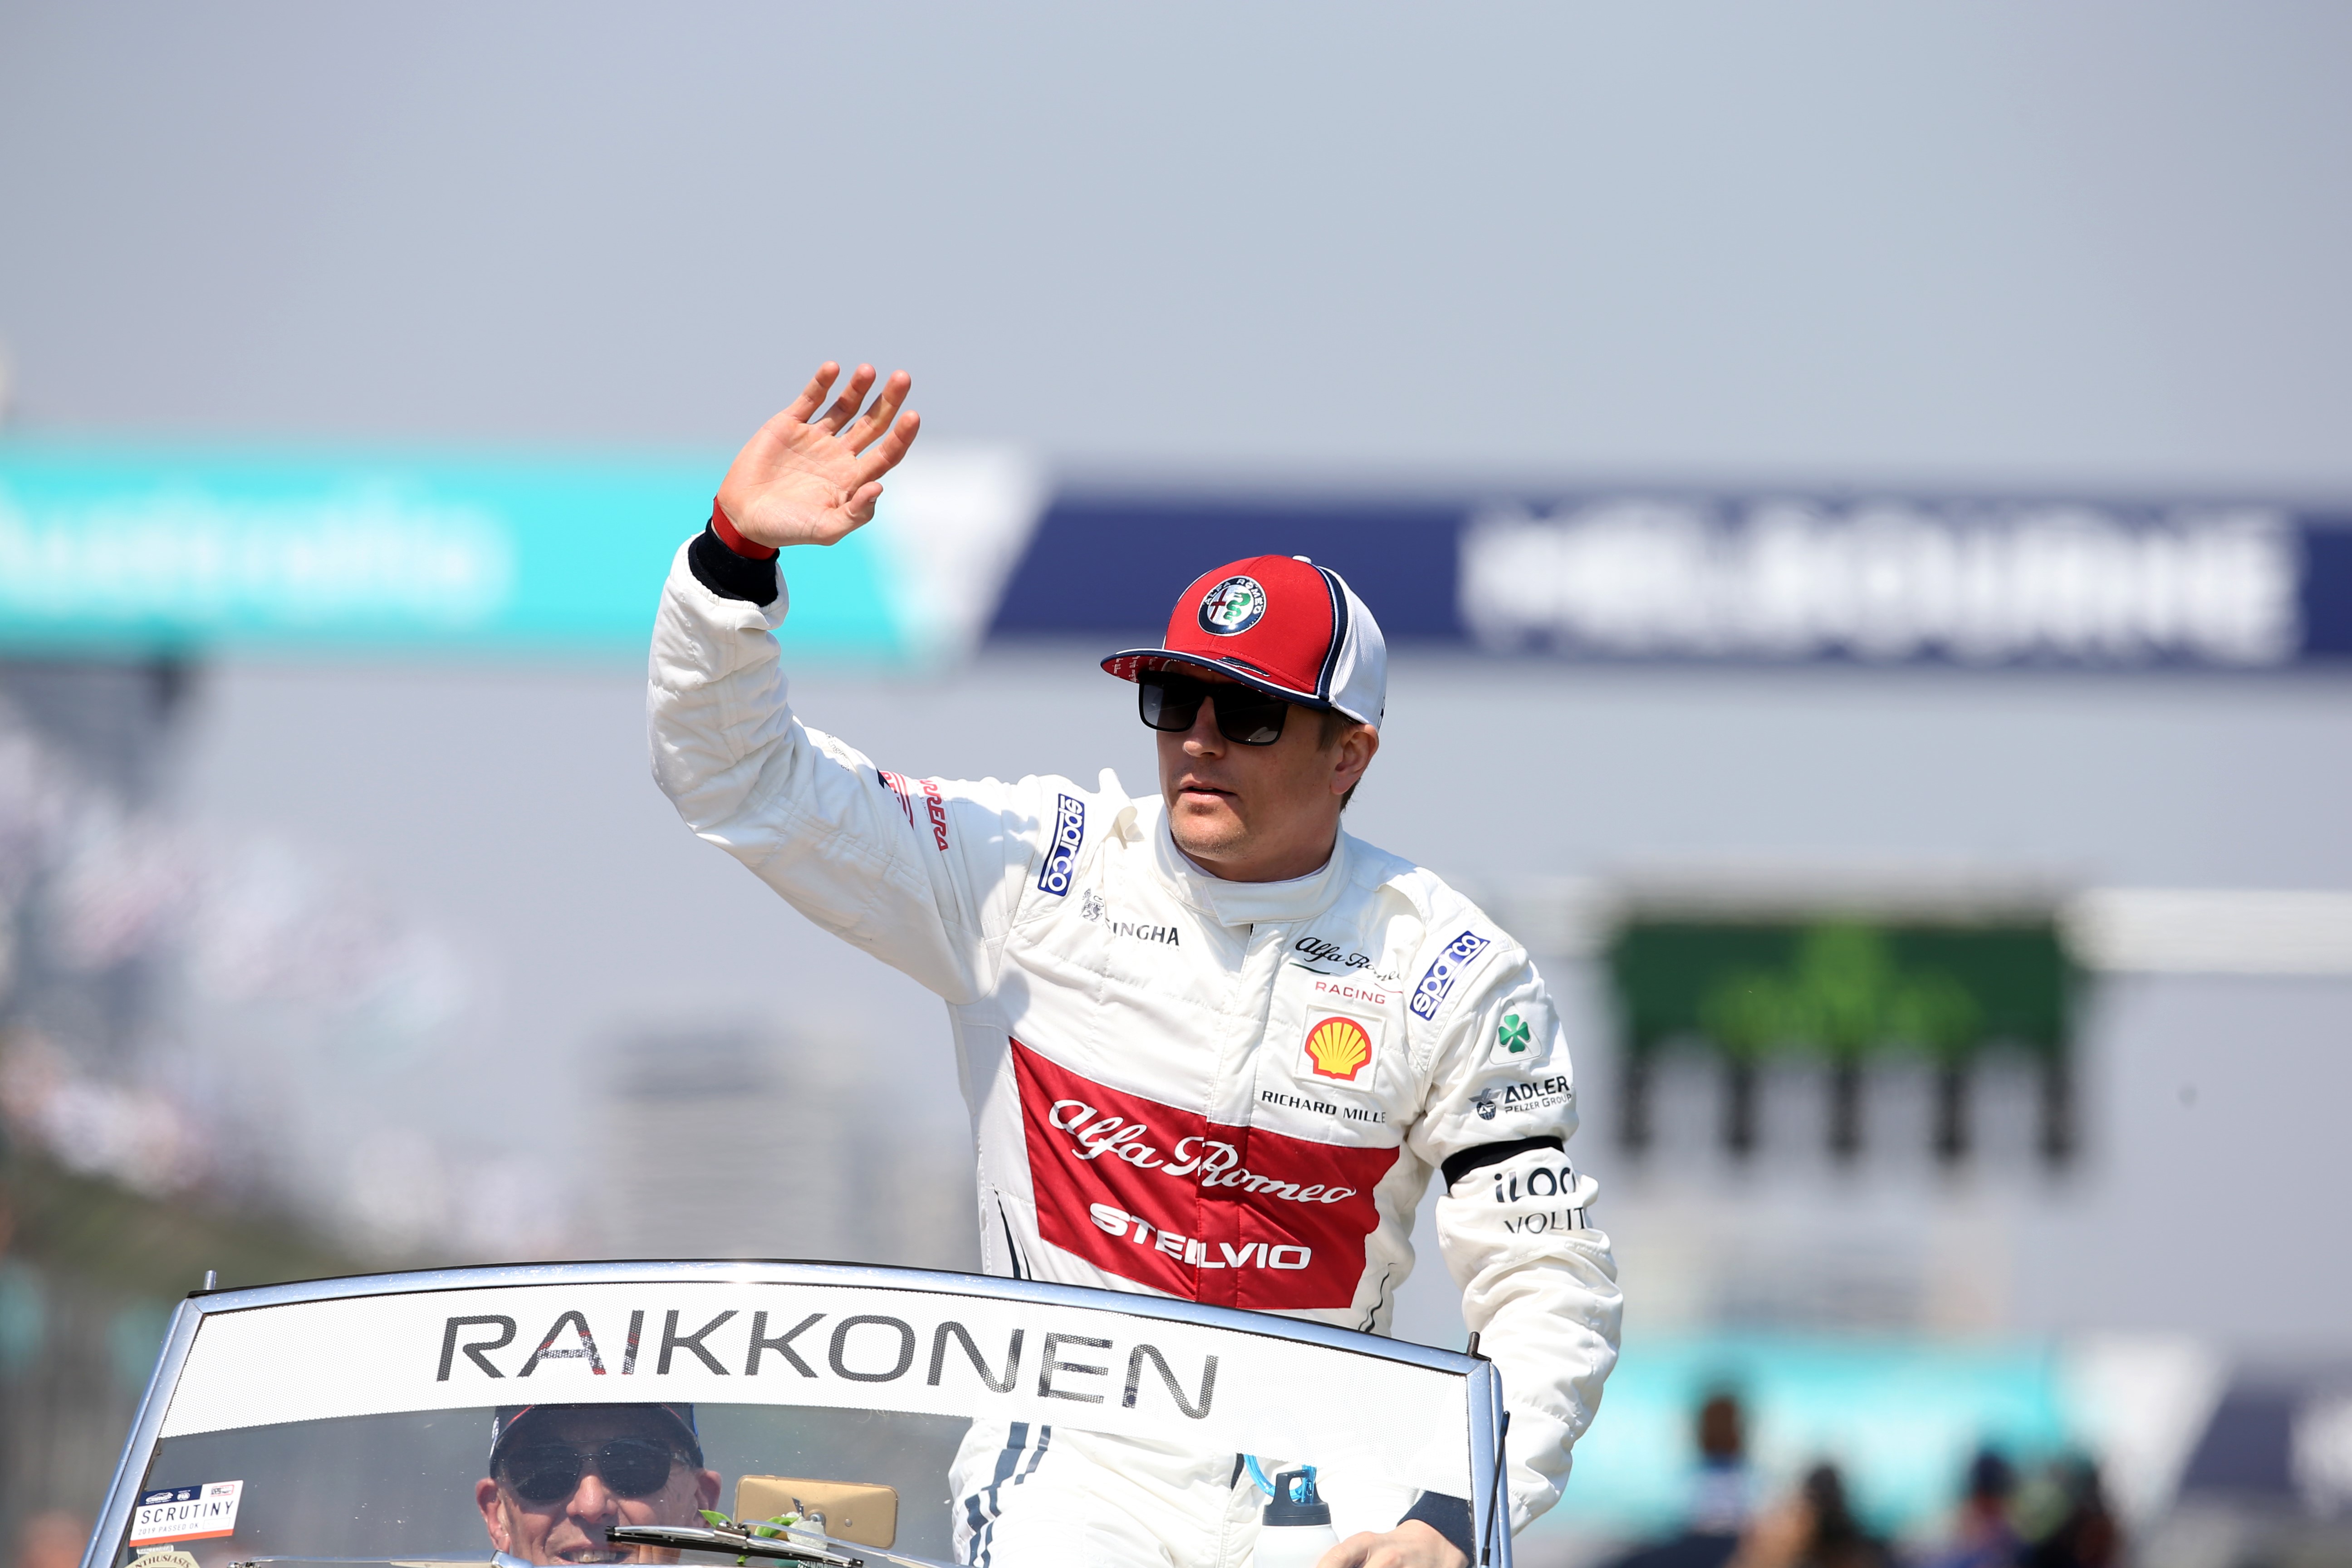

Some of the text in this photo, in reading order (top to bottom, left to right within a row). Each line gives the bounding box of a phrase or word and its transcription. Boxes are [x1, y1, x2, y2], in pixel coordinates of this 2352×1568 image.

[1205, 579, 1264, 614] ALFA ROMEO
[1047, 798, 1083, 892] sparco
[1295, 937, 1345, 962] Alfa
[1413, 935, 1481, 1013] sparco
[1315, 981, 1386, 1004] RACING
[1504, 1076, 1570, 1104] ADLER
[1261, 1090, 1386, 1123] RICHARD MILLE
[1504, 1102, 1541, 1114] PELZER
[1049, 1099, 1357, 1204] Alfa Romeo
[437, 1309, 1220, 1419] RAIKKONEN
[141, 1500, 234, 1524] SCRUTINY
[158, 1524, 186, 1533] PASSED
